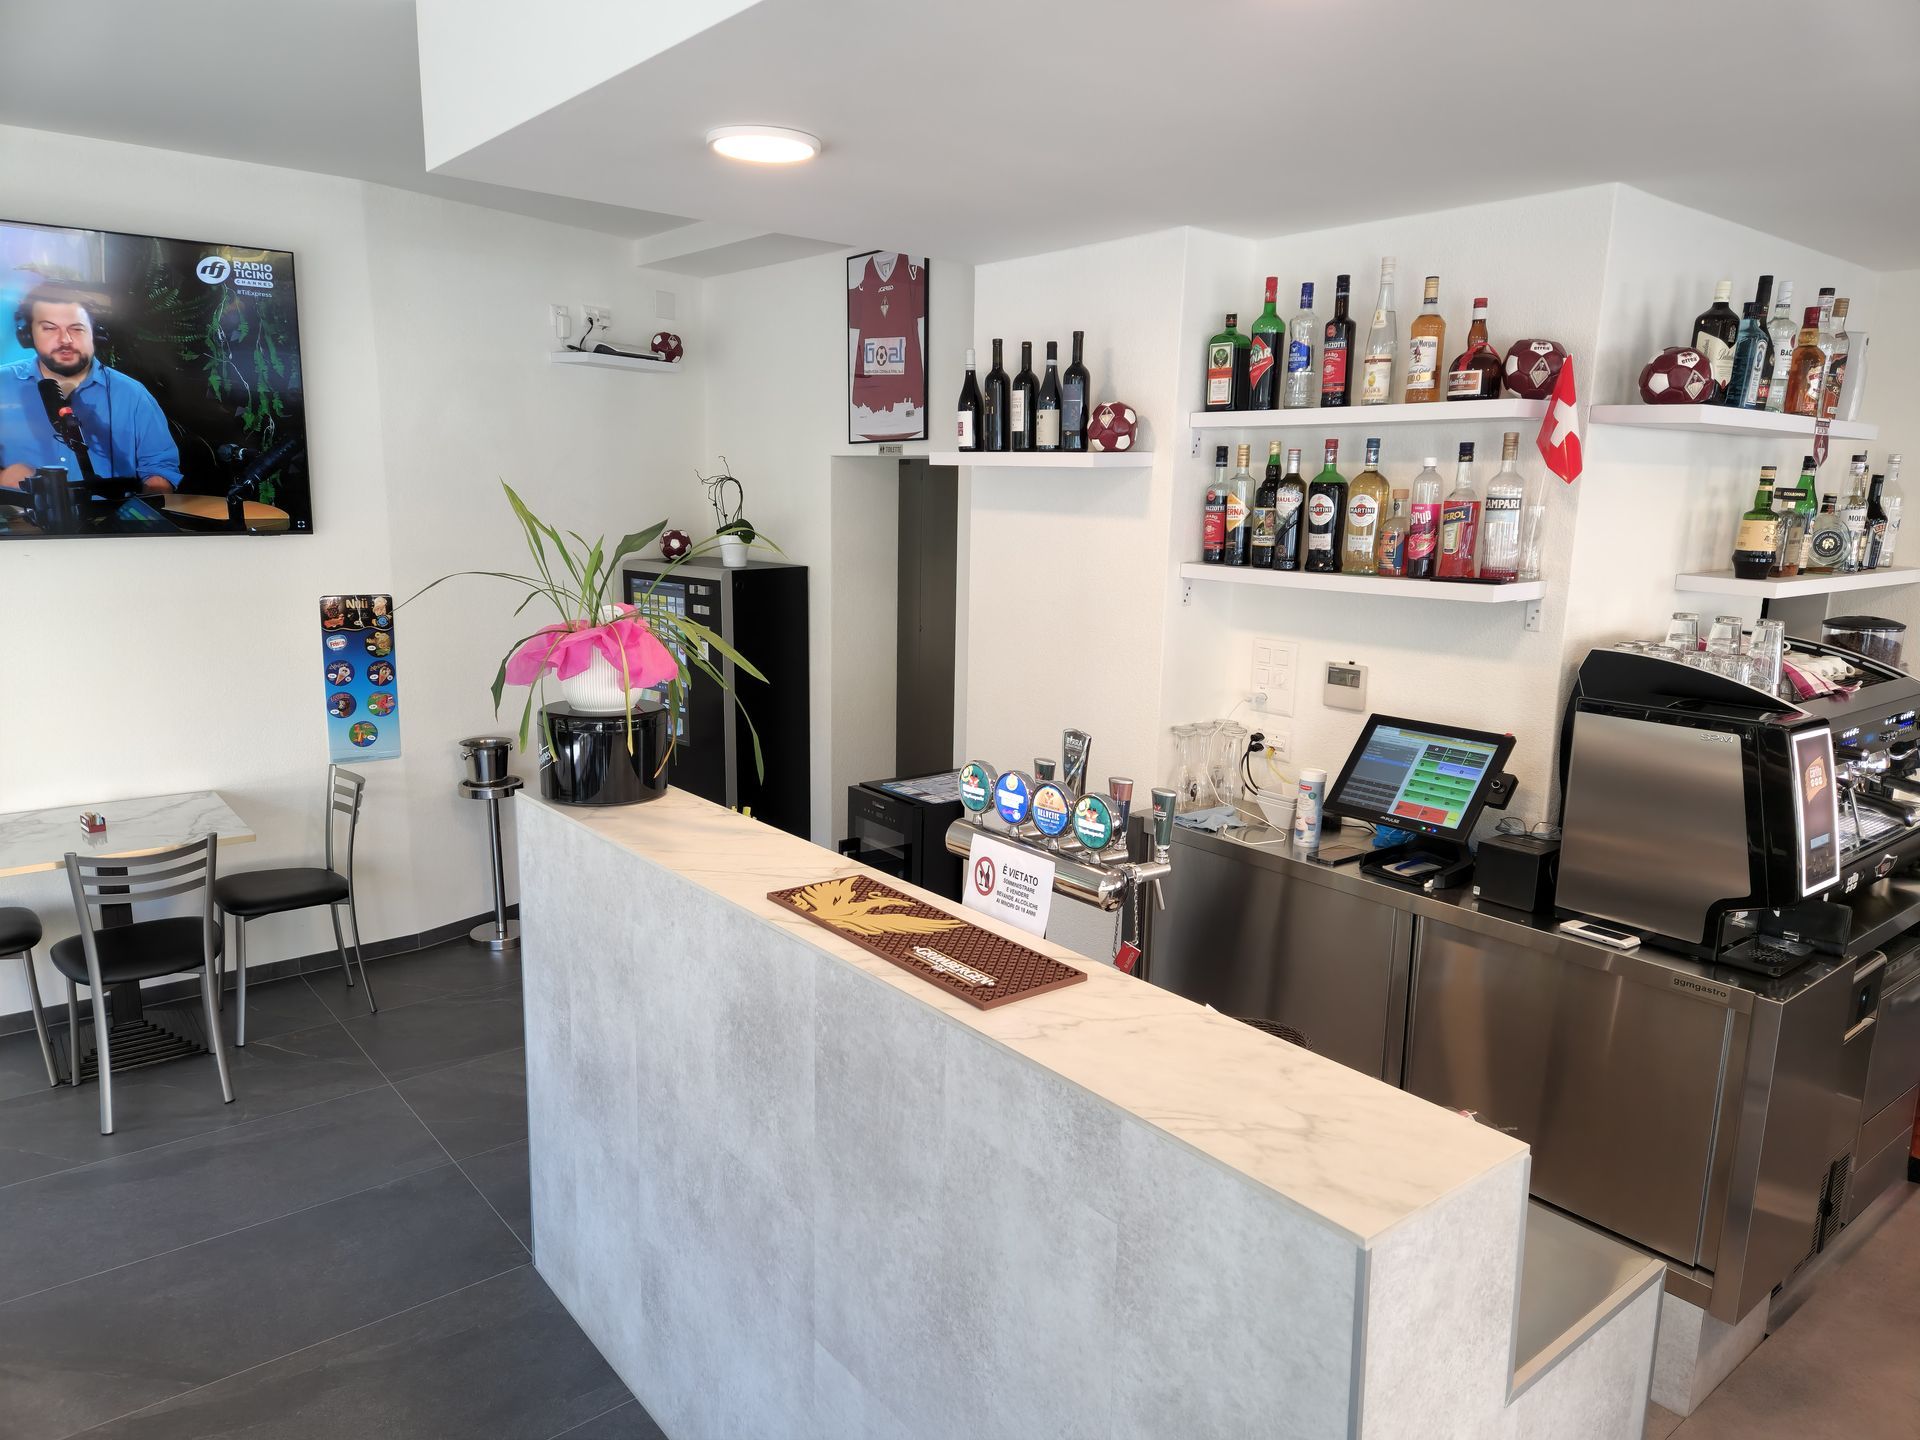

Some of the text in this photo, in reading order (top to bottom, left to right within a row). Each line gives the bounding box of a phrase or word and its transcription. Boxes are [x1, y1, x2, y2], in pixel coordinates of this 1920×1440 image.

[233, 261, 272, 272] RADIO
[234, 269, 273, 280] TICINO
[1310, 506, 1333, 514] MARTINI
[1700, 734, 1734, 743] SPM
[1009, 868, 1038, 886] VIETATO
[1003, 877, 1035, 894] SOMMINISTRARE
[996, 890, 1038, 910] BEVANDE ALCOLICHE
[1010, 889, 1029, 899] VENDERE
[915, 947, 992, 986] GRIMBERGEN
[1673, 978, 1727, 998] ggmgastro
